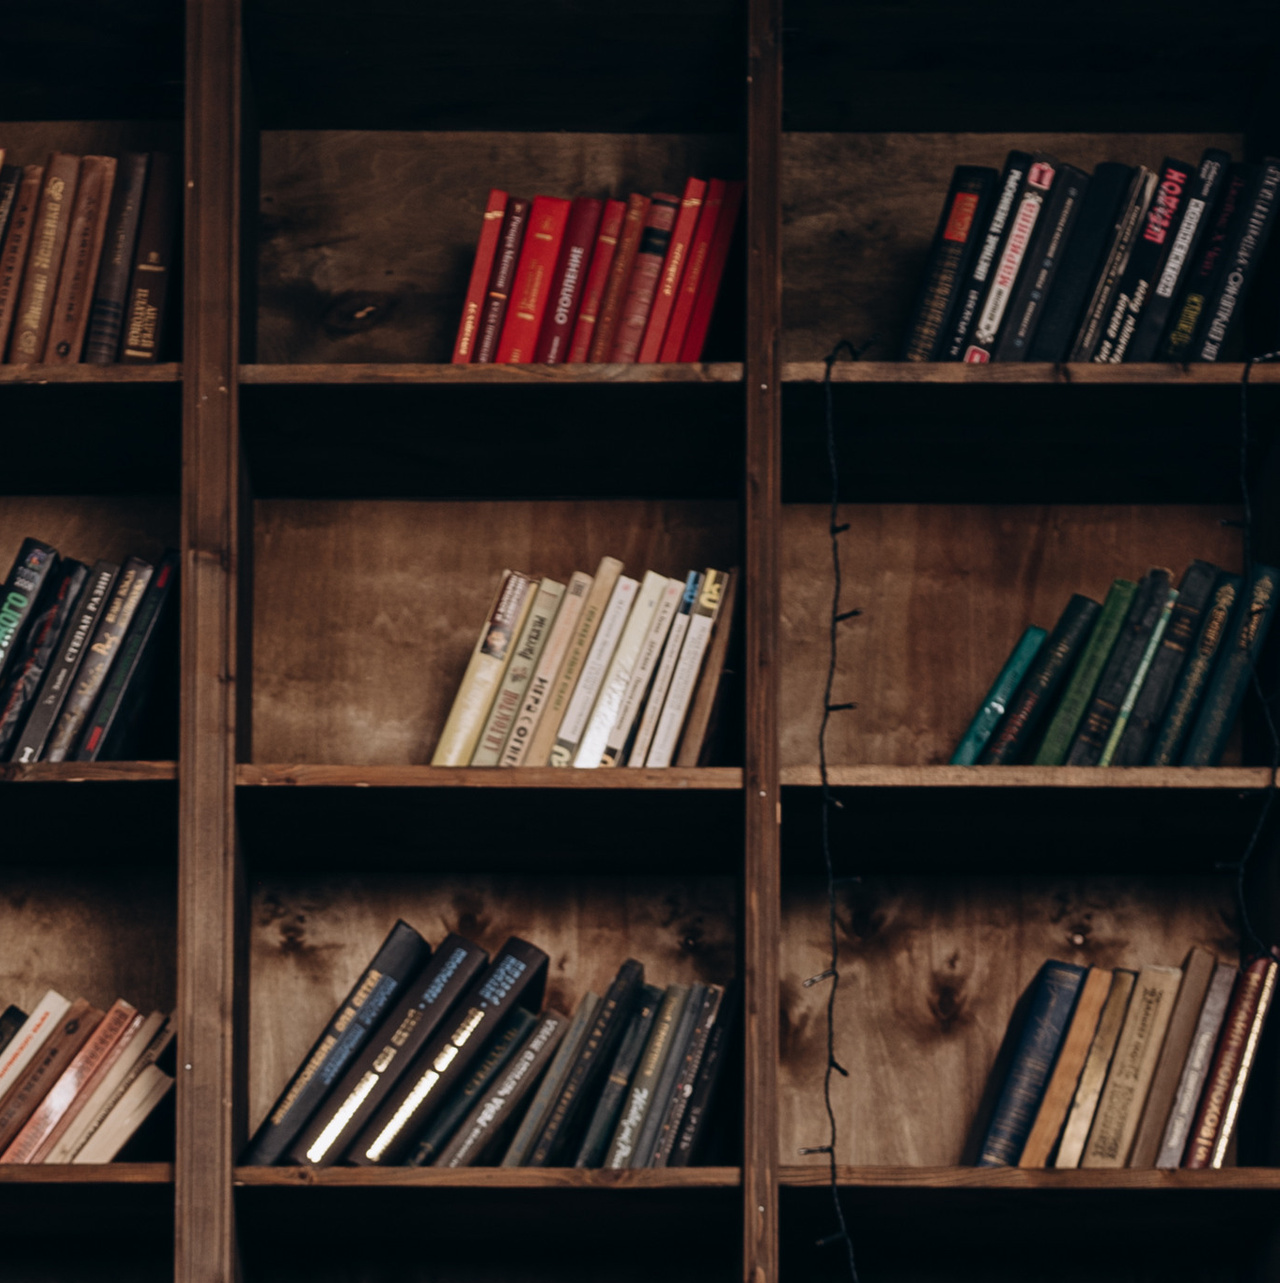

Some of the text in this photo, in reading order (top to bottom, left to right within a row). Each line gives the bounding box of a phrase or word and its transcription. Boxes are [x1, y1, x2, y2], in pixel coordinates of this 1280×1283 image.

[972, 167, 1023, 282] ЦВЕТНЫЕ ТЕЛЕВИЗОРЫ
[1143, 167, 1187, 244] ШЕЛДОН
[1156, 197, 1204, 298] КОННЕКТОМ
[553, 244, 584, 325] ОТОПЛЕНИЕ
[1104, 291, 1132, 339] ангелов
[1126, 278, 1150, 313] богов
[62, 613, 93, 663] СТЕПАН
[86, 570, 112, 612] РАЗИН
[526, 676, 547, 713] ИГРА
[269, 967, 383, 1126] ЭНЦИКЛОПЕДИЯ ДЛЯ ДЕТЕЙ
[475, 1016, 558, 1129] РЕЙД ЧЕРНОГО ЖУКА
[1199, 1049, 1238, 1138] ШОЛОХОВ
